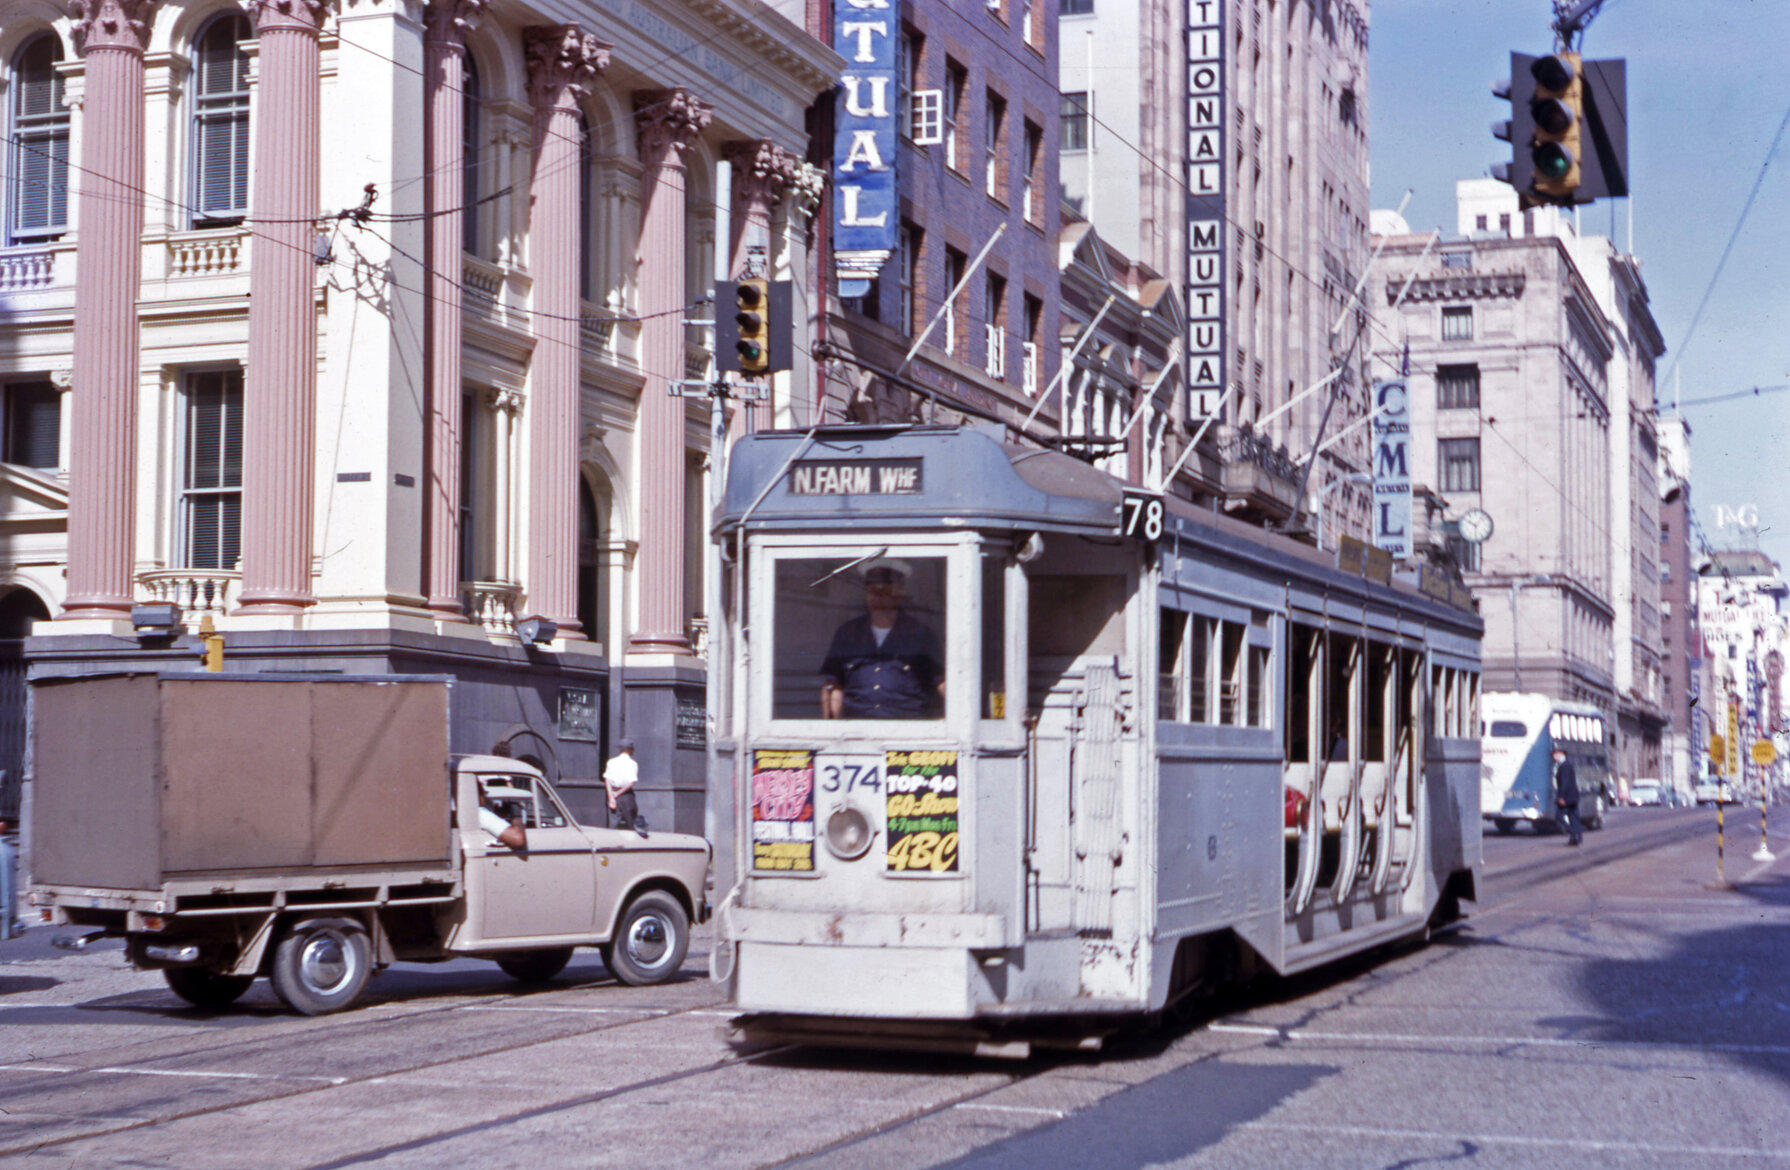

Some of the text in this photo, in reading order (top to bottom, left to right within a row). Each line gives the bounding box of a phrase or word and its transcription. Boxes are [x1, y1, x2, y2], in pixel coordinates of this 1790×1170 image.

[704, 48, 735, 87] BANK
[741, 72, 783, 115] LIMITED
[840, 0, 890, 228] TUAL
[1193, 225, 1217, 416] MUTUAL
[795, 466, 871, 494] N.FARM
[1125, 498, 1163, 540] 78
[822, 765, 882, 793] 374
